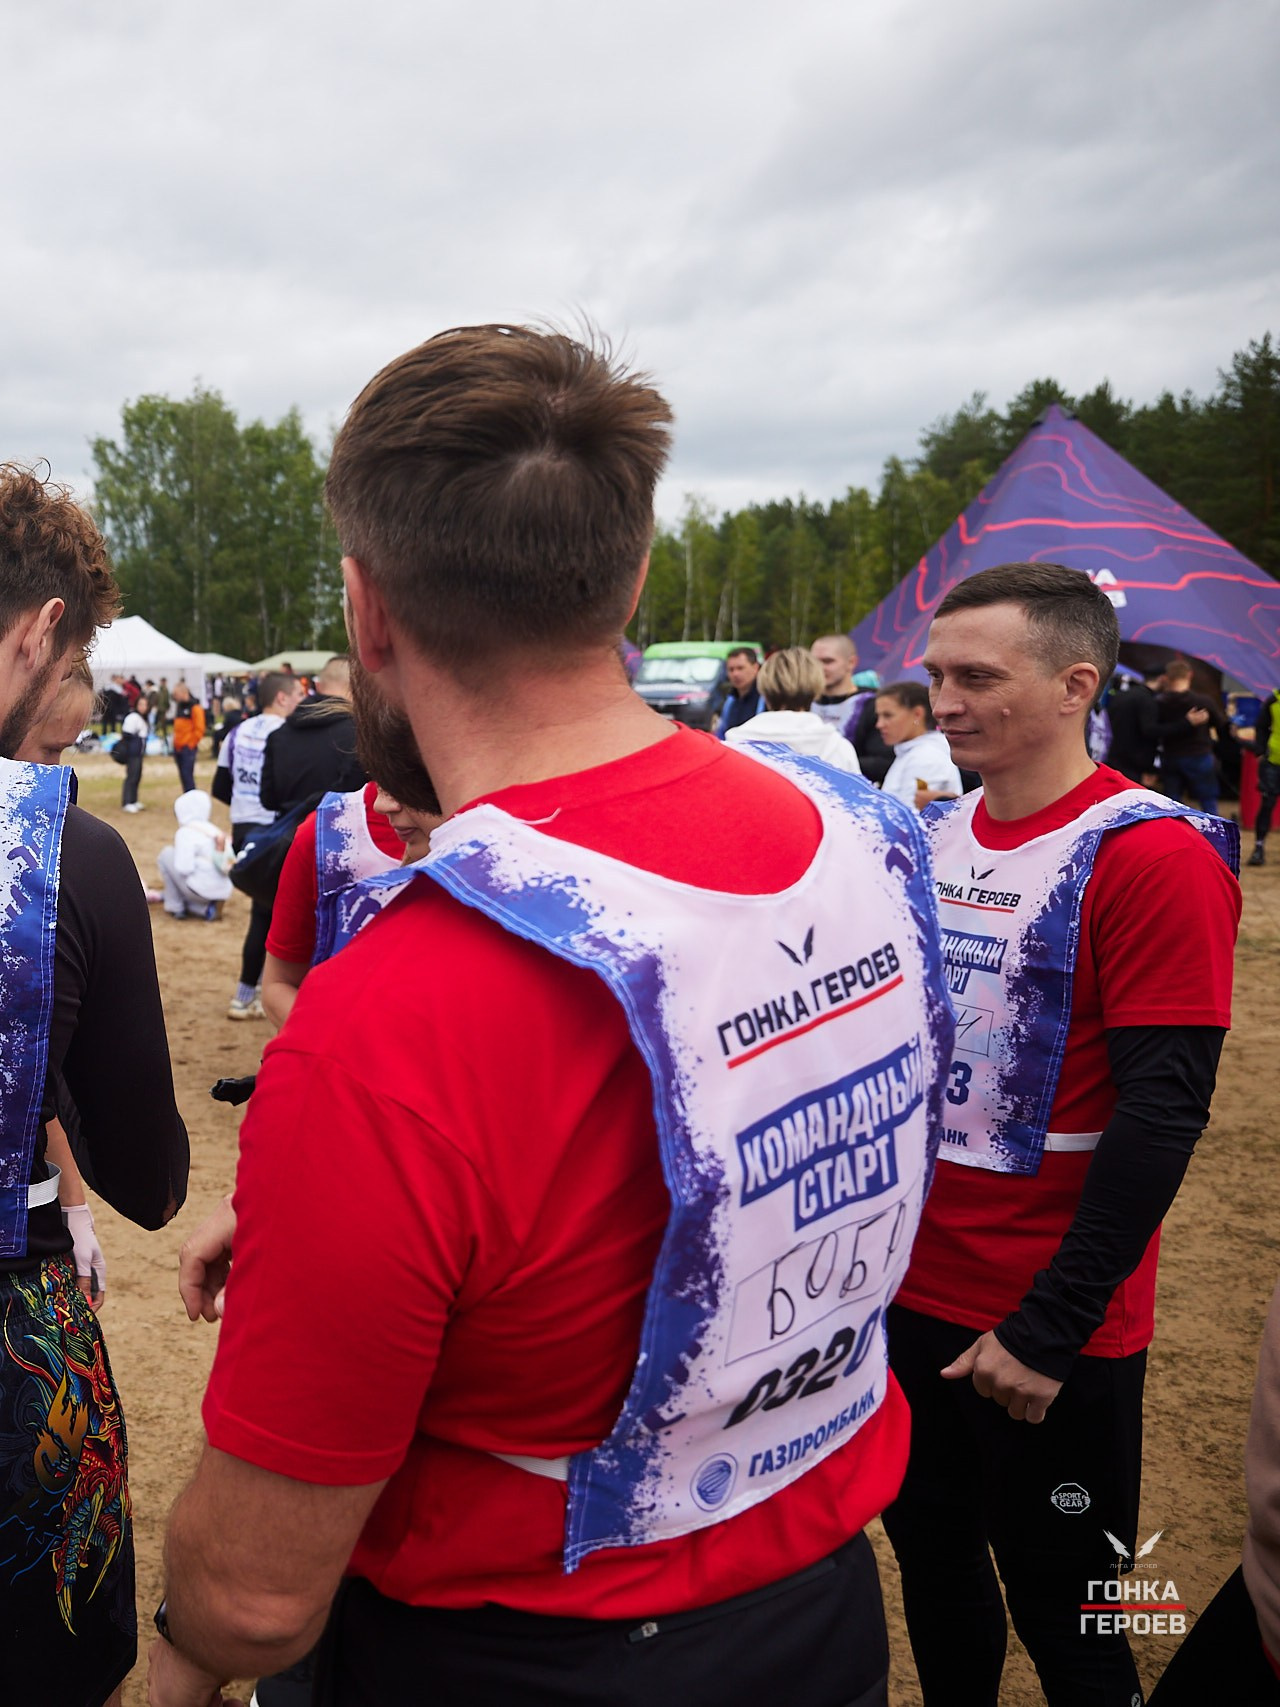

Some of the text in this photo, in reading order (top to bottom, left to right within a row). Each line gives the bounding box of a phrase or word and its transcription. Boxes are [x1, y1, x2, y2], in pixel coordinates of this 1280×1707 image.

[935, 882, 1022, 908] ОНКА ГЕРОЕВ
[717, 942, 901, 1056] ГОНКА ГЕРОЕВ
[944, 964, 969, 991] АРТ
[742, 1032, 923, 1194] КОМАНДНЫЙ
[798, 1133, 890, 1219] СТАРТ
[722, 1284, 893, 1430] 0320
[748, 1382, 876, 1477] ГАЗПРОМБАНК
